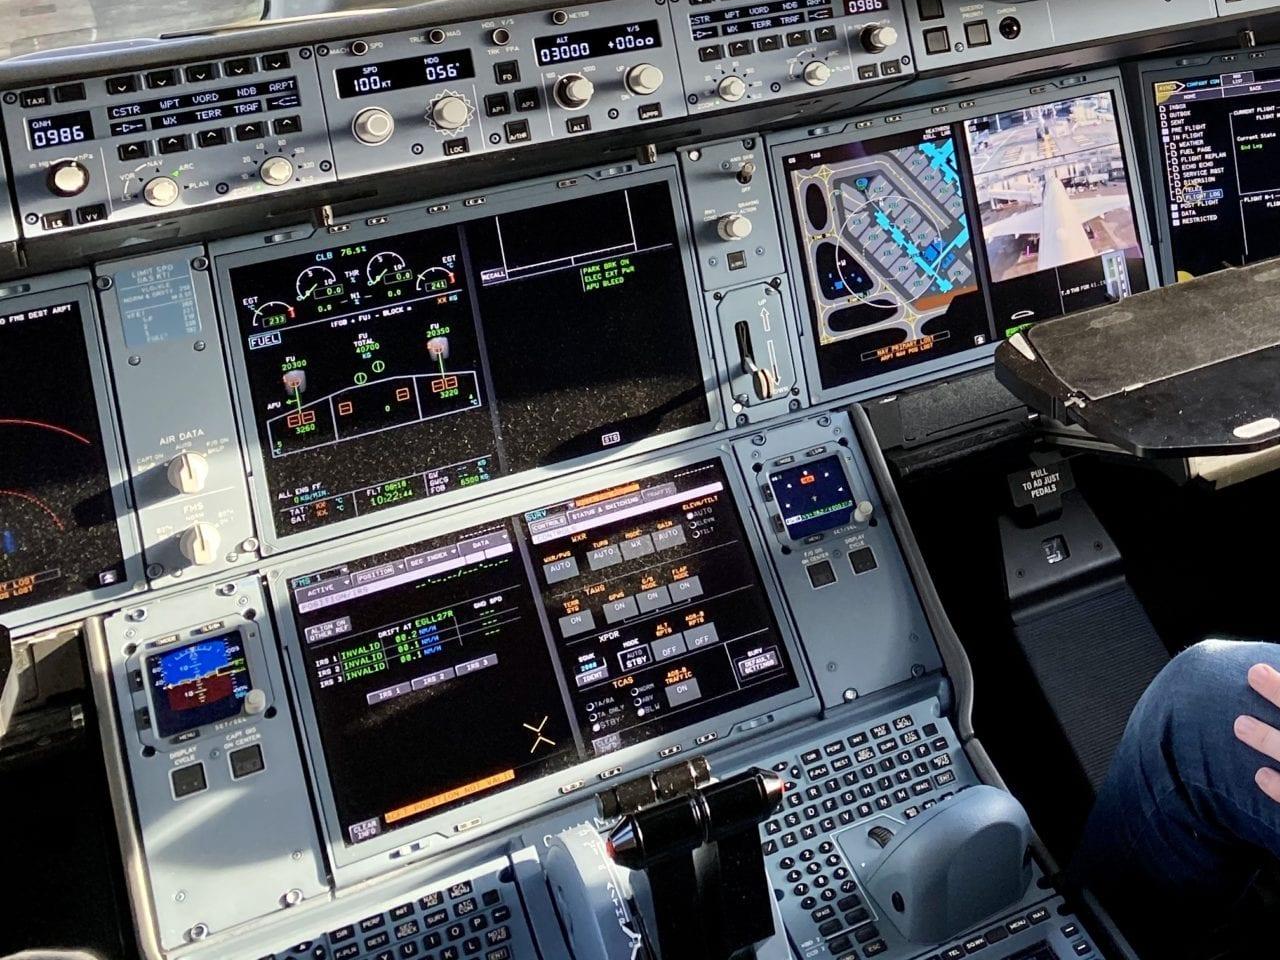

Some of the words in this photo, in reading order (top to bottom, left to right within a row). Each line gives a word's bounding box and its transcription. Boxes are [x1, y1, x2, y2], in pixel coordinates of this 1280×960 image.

[752, 19, 772, 29] TERR
[780, 15, 800, 25] TRAF
[540, 43, 590, 62] 03000
[362, 66, 378, 74] SPD
[268, 80, 295, 92] ARPT
[353, 78, 380, 91] 100
[236, 87, 257, 97] NDB
[160, 99, 181, 109] WPT
[192, 93, 219, 104] VORD
[113, 106, 140, 117] CSTR
[234, 103, 259, 114] TRAF
[195, 109, 222, 121] TERR
[31, 120, 51, 129] QNH
[163, 116, 177, 126] WX
[573, 124, 586, 132] ALT
[34, 129, 85, 147] 0986
[449, 146, 463, 154] LOC
[52, 305, 71, 314] ARPT
[251, 335, 278, 348] FUEL
[356, 343, 380, 354] 40700
[282, 360, 307, 371] 20300
[159, 435, 175, 445] AIR
[177, 428, 205, 441] DATA
[1031, 468, 1048, 479] PULL
[1022, 482, 1032, 491] TO
[1031, 484, 1056, 498] PEDALS
[659, 529, 678, 540] AUTO
[472, 539, 490, 548] DATA
[593, 548, 614, 558] AUTO
[550, 561, 571, 572] AUTO
[307, 584, 334, 596] ACTIVE
[679, 581, 690, 589] ON
[647, 592, 658, 600] ON
[614, 602, 626, 611] ON
[570, 616, 582, 625] ON
[599, 630, 620, 642] XPDR
[695, 635, 709, 646] OFF
[341, 641, 382, 660] INVALID
[662, 646, 677, 657] OFF
[343, 652, 383, 670] INVALID
[626, 656, 647, 668] STBY
[346, 662, 386, 681] INVALID
[613, 677, 634, 689] TCAS
[676, 685, 688, 693] ON
[353, 822, 377, 834] CLEAR
